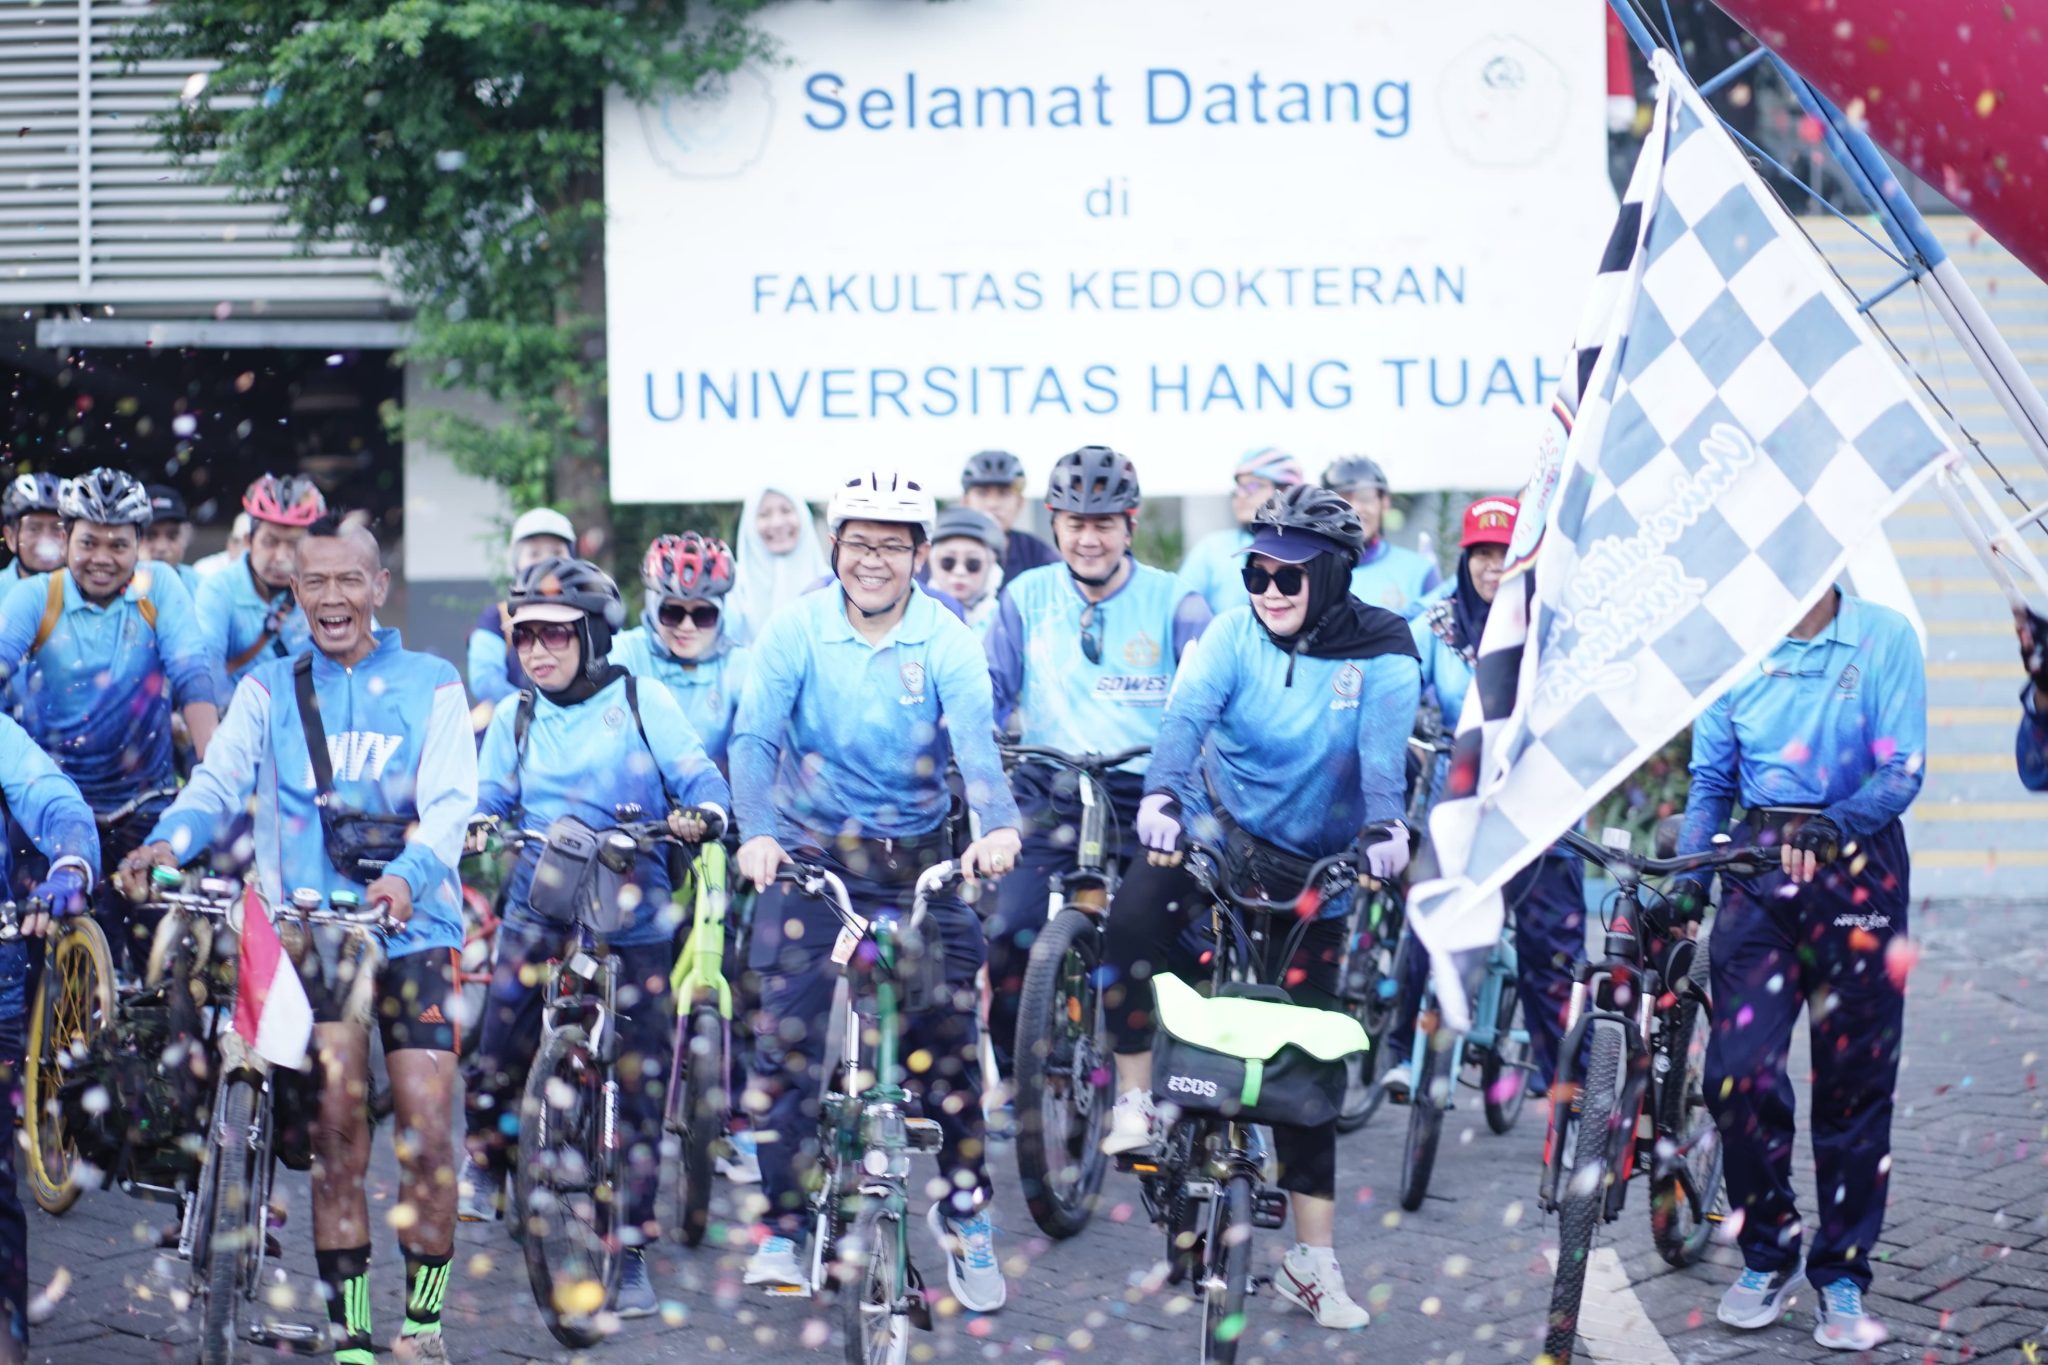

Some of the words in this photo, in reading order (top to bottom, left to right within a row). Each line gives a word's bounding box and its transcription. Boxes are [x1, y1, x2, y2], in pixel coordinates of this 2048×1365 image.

[803, 71, 1114, 132] Selamat
[1145, 67, 1413, 139] Datang
[1085, 178, 1130, 218] di
[753, 272, 1044, 314] FAKULTAS
[1069, 265, 1466, 310] KEDOKTERAN
[645, 364, 1120, 423] UNIVERSITAS
[1150, 360, 1354, 413] HANG
